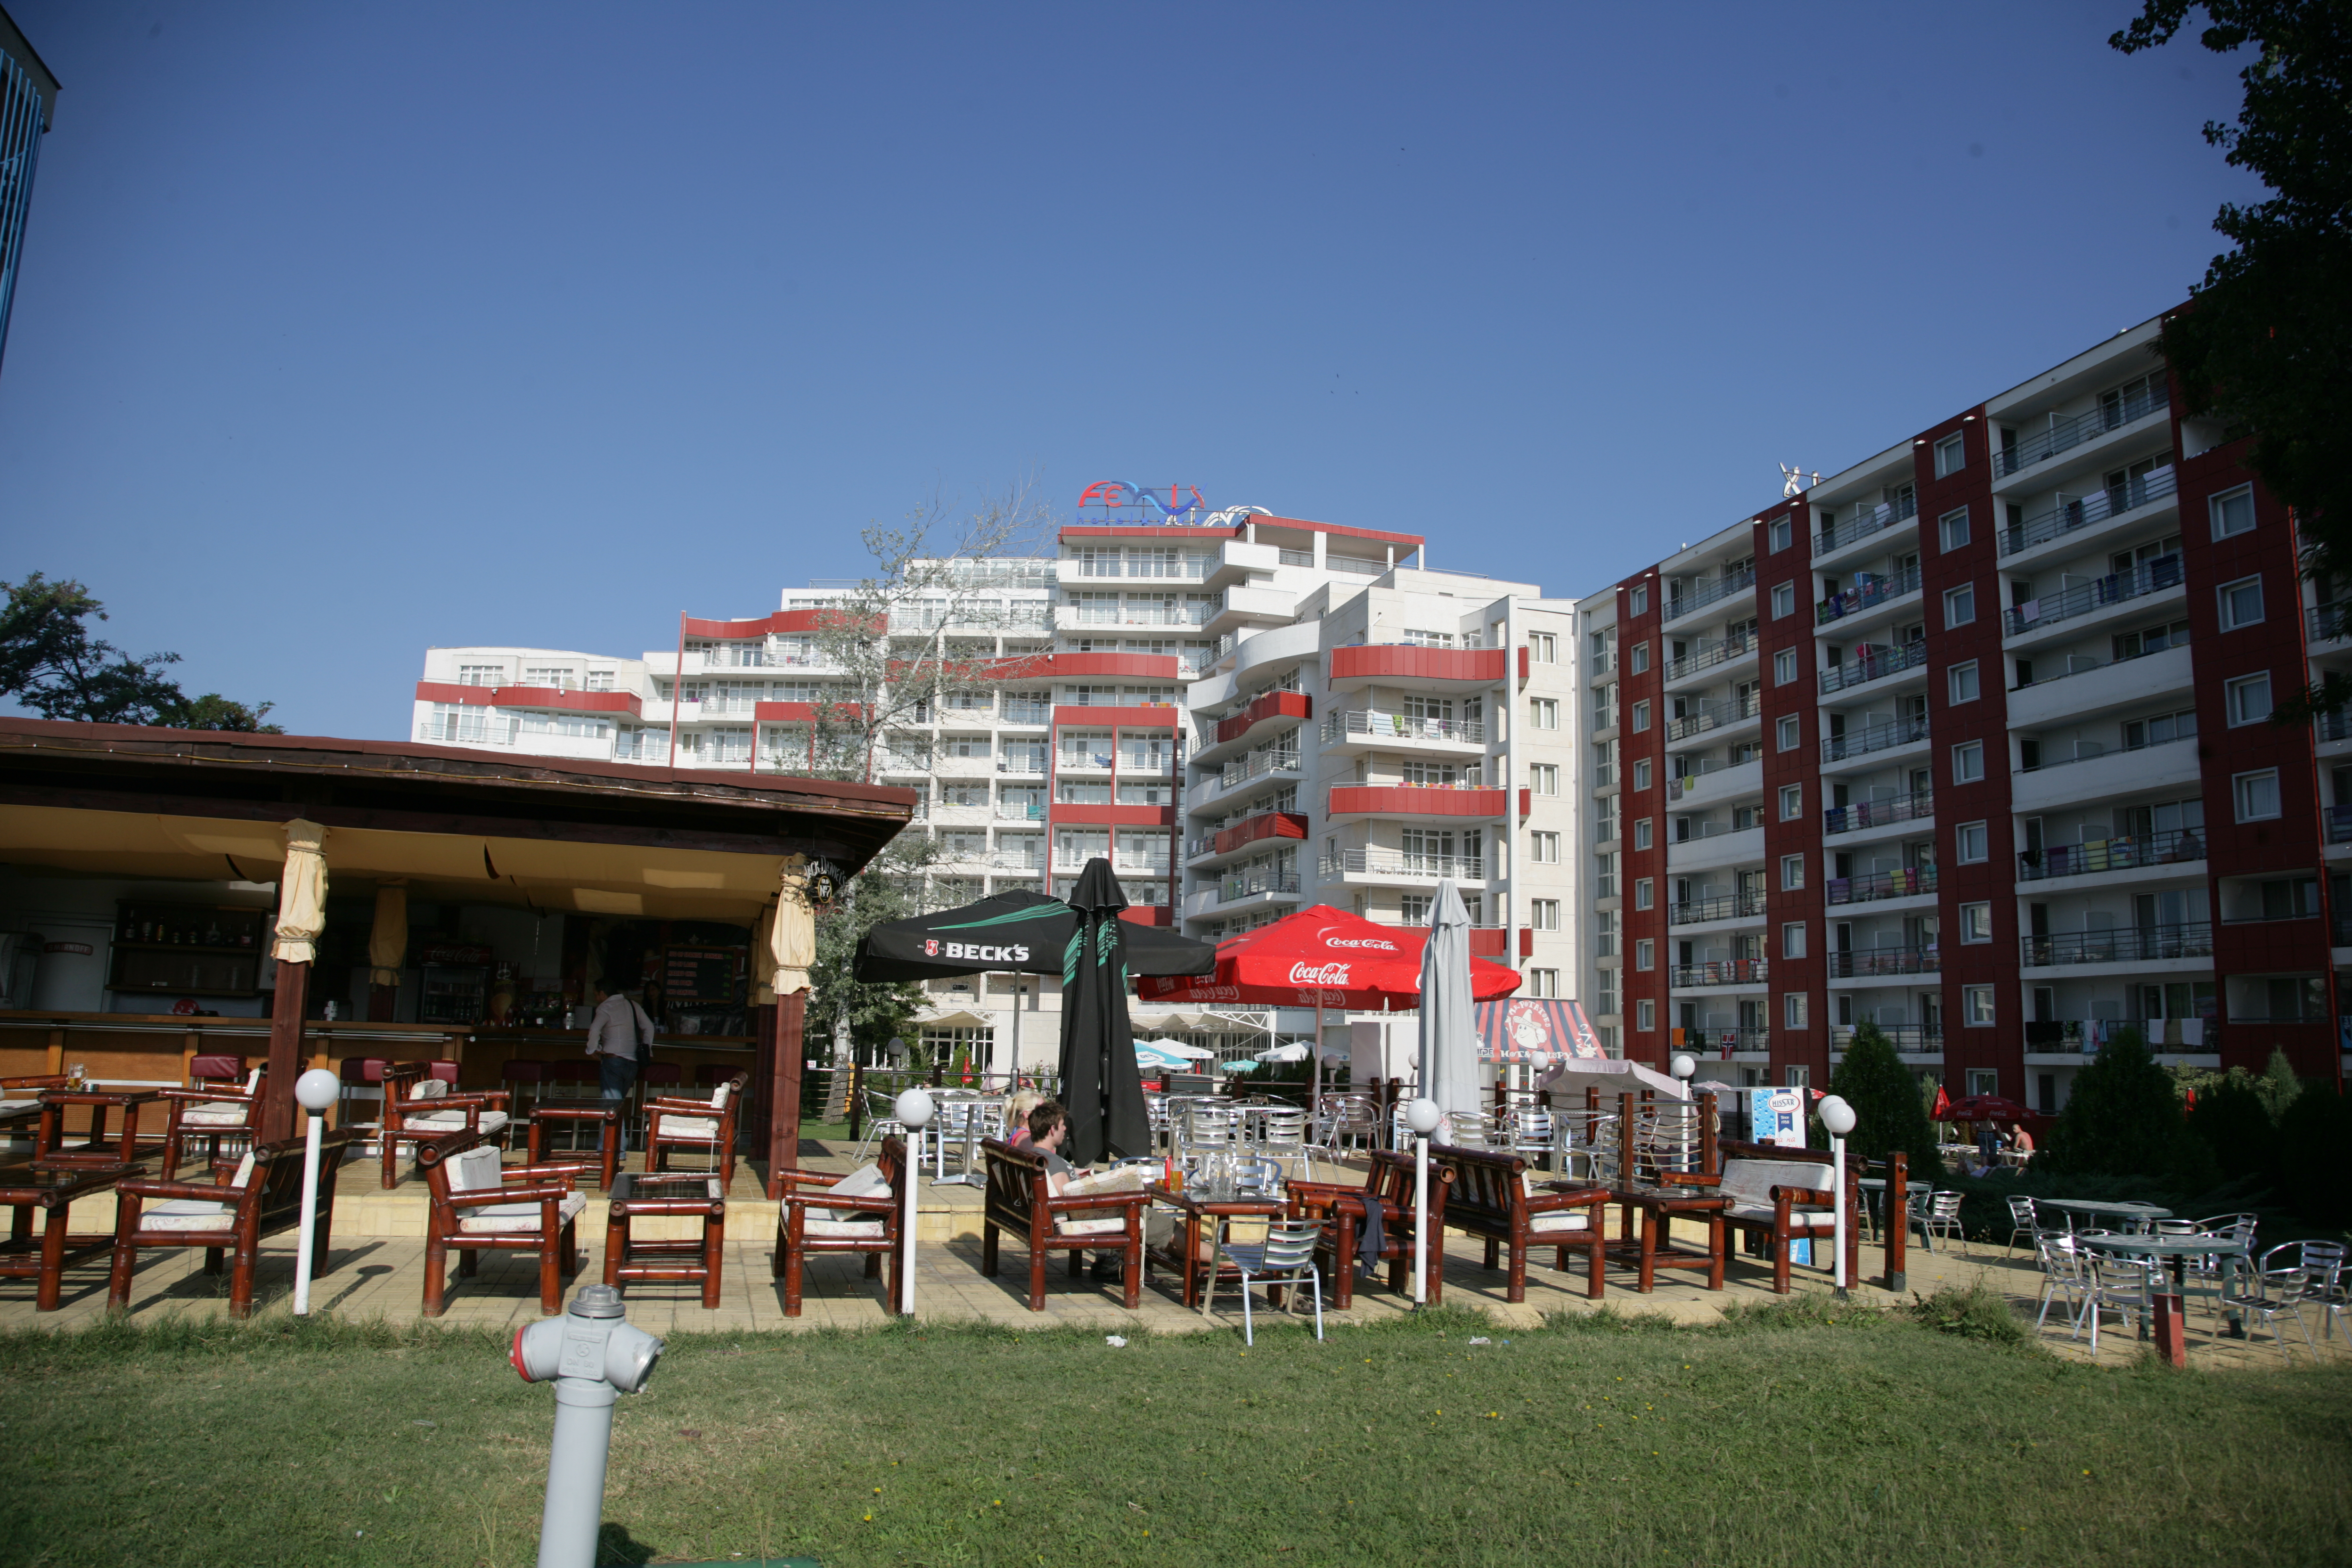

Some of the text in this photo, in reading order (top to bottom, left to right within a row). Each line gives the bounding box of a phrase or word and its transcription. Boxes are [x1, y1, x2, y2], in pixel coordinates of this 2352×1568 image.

[1076, 512, 1134, 524] hotel
[803, 861, 820, 882] JACK
[48, 944, 89, 953] SMIRNOFF
[946, 942, 1029, 961] BECK'S
[1326, 938, 1398, 950] Coca-Cola
[431, 945, 483, 963] Coca-Cola
[1289, 962, 1351, 985] Coca-Cola
[1772, 1099, 1795, 1107] HISSAR
